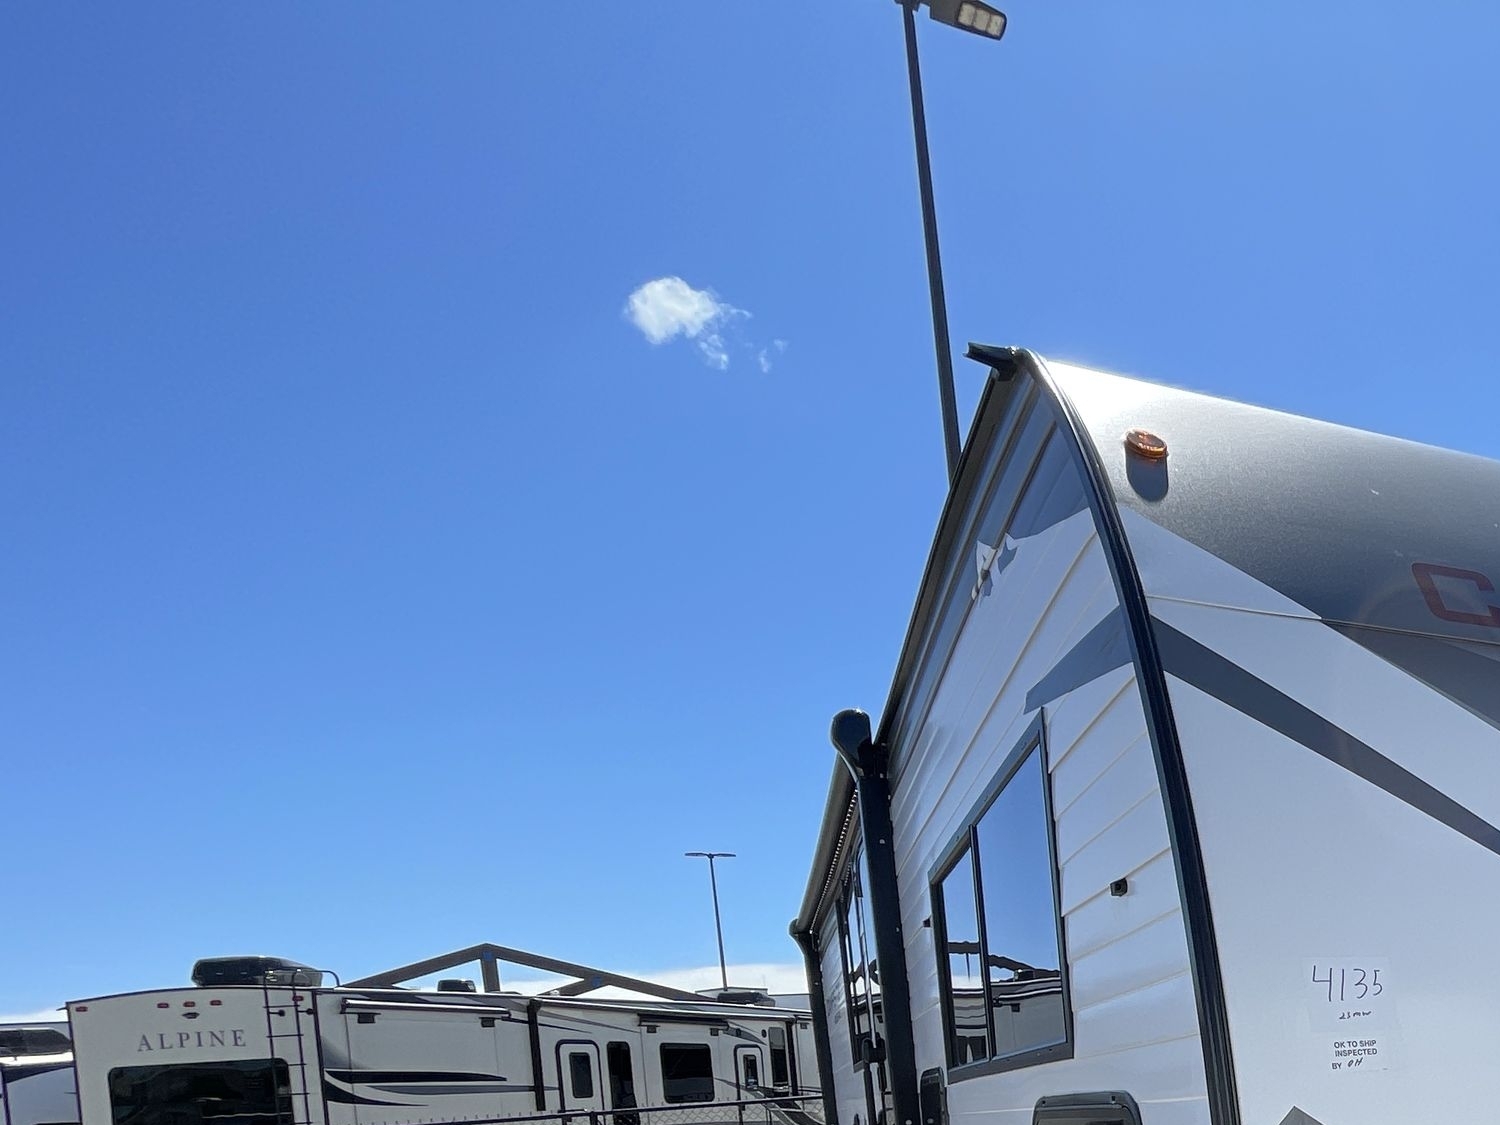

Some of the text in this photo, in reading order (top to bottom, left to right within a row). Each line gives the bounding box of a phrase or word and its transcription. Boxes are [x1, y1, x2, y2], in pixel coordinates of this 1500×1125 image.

[1311, 964, 1384, 1002] 4135
[137, 1029, 248, 1052] ALPINE
[1334, 1039, 1377, 1049] OK TO SHIP
[1334, 1048, 1378, 1057] INSPECTED
[1331, 1062, 1342, 1070] BY
